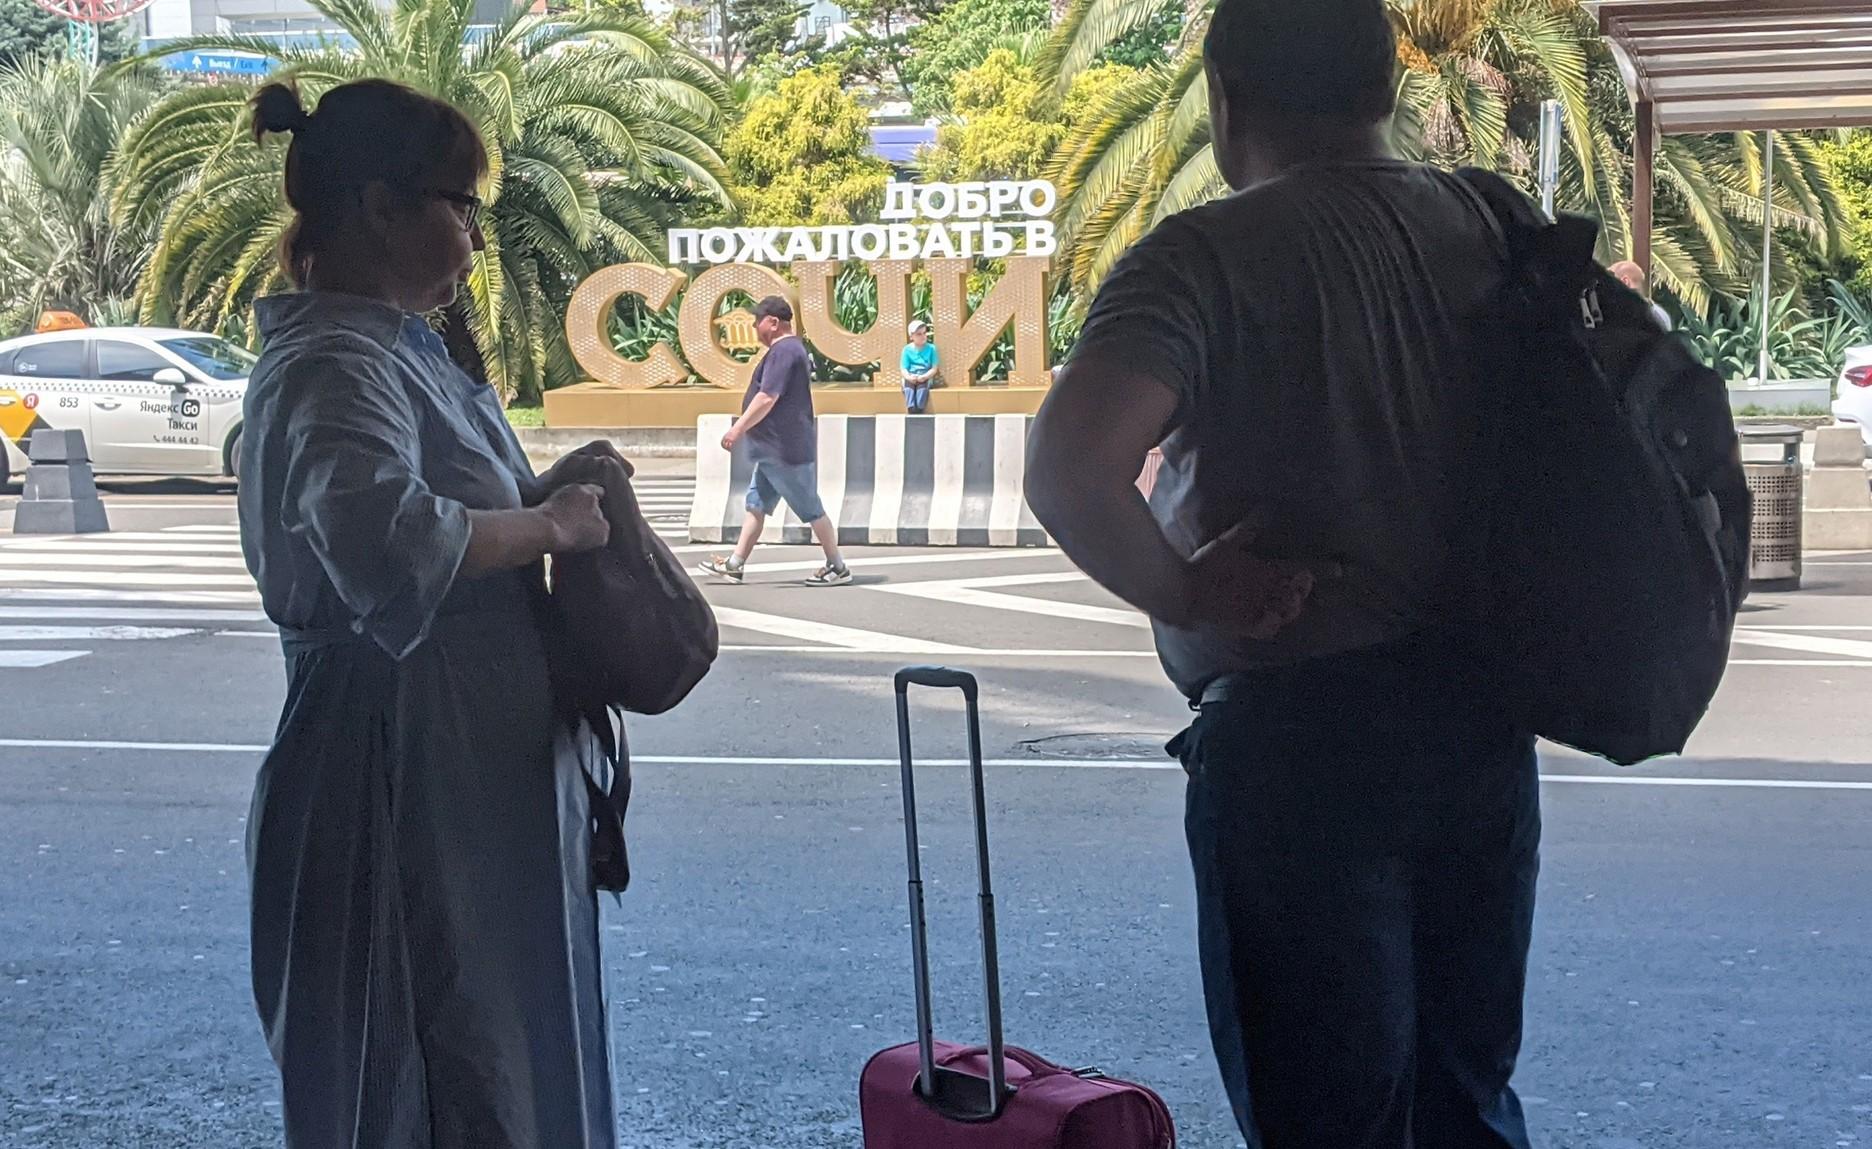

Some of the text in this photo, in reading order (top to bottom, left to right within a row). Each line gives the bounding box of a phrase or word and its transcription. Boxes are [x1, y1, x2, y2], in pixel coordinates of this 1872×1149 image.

[880, 179, 1058, 220] ДОБРО
[667, 220, 1058, 264] ПОЖАЛОВАТЬ В
[565, 257, 1054, 389] СОЧИ
[26, 394, 36, 409] Я
[59, 397, 79, 408] 853
[140, 400, 200, 416] Яндекс Go
[167, 417, 198, 431] Такси
